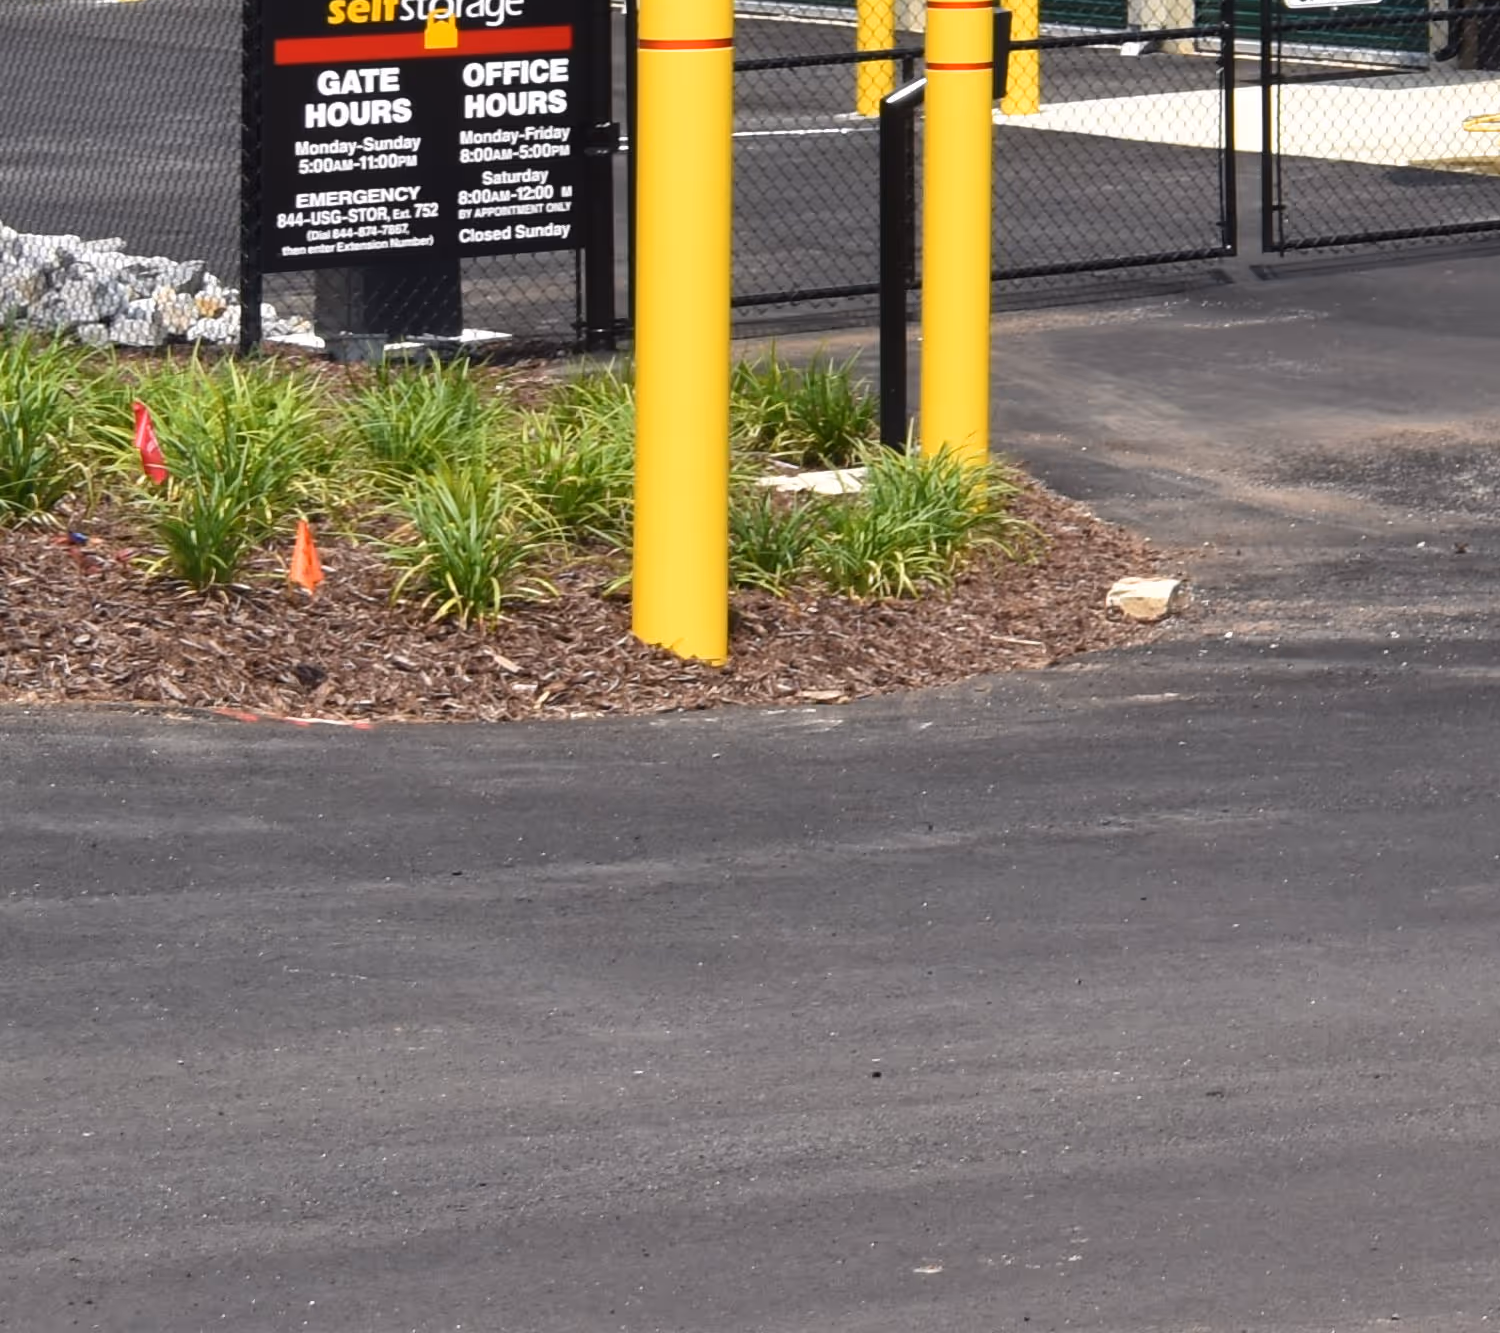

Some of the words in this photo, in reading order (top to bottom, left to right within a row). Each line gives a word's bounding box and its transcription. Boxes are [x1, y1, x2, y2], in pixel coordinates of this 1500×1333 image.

[317, 67, 400, 95] GATE
[462, 58, 569, 87] OFFICE
[305, 98, 412, 128] HOURS
[464, 89, 567, 119] HOURS
[295, 135, 421, 156] Monday-Sunday
[459, 125, 571, 145] Monday-Friday
[460, 144, 570, 163] 8:00AM-5:00PM
[482, 168, 549, 185] Saturday
[296, 186, 421, 208] EMERGENCY
[414, 202, 439, 218] 752
[458, 209, 472, 220] BY
[474, 204, 543, 218] APPOINTMENT
[546, 201, 572, 213] ONLY
[459, 226, 511, 243] Closed
[515, 222, 571, 239] Sunday
[336, 238, 388, 253] Extension
